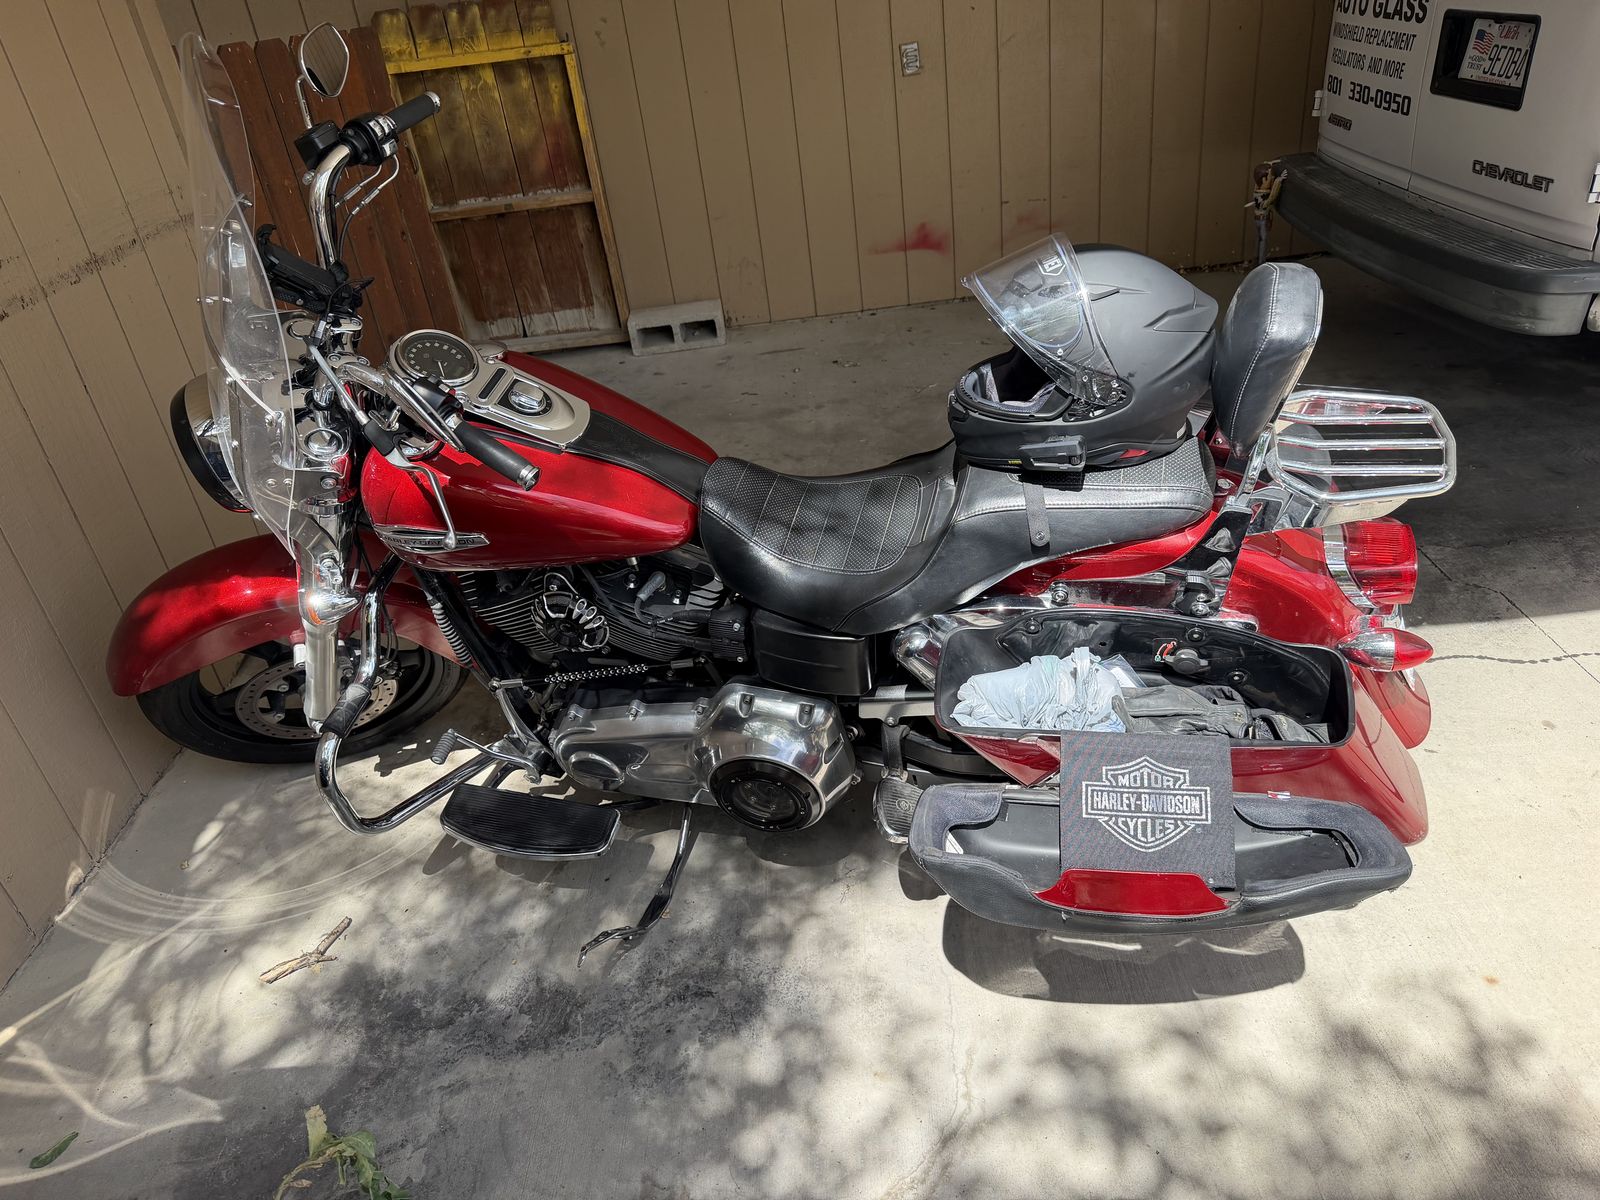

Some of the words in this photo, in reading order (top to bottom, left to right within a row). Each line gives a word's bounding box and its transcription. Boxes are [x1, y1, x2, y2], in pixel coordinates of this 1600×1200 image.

[1372, 0, 1429, 24] GLASS
[1364, 26, 1417, 52] REPLACEMENT
[1331, 47, 1366, 71] REGULATORS
[1367, 56, 1383, 75] AND
[1382, 58, 1406, 80] MORE
[1327, 74, 1343, 97] 801
[1348, 81, 1412, 117] 330-0950
[1472, 159, 1555, 193] CHEVROLET
[1117, 767, 1175, 789] MOTOR
[1093, 791, 1201, 815] HARLEY-DAVIDSON
[1117, 817, 1175, 843] CYCLES
